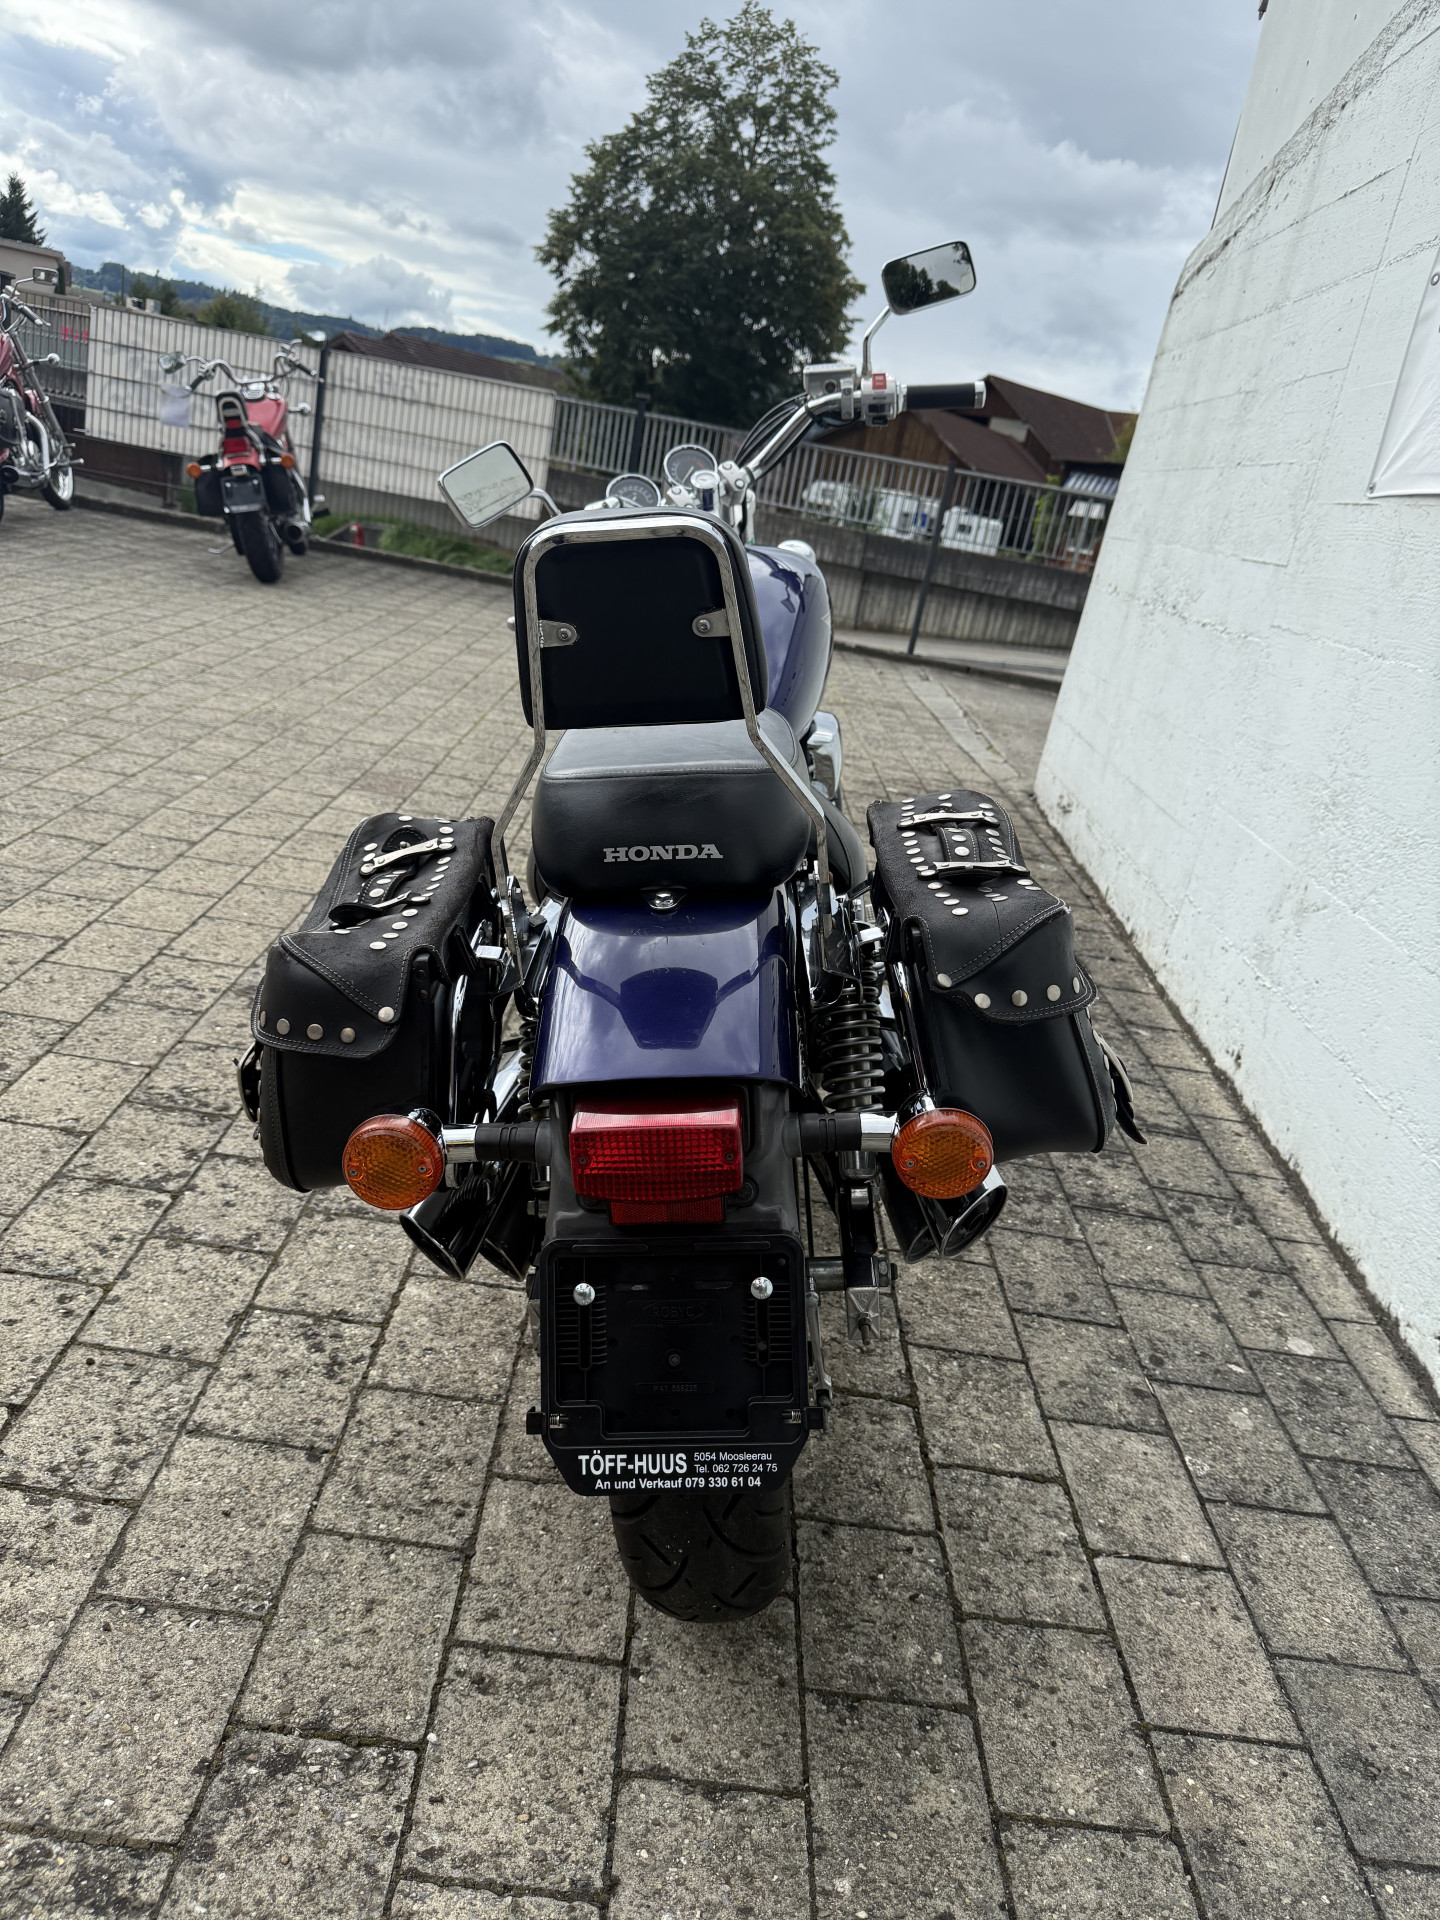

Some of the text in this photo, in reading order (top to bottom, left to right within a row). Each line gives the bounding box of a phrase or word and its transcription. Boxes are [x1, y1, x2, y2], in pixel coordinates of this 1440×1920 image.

[603, 844, 724, 863] HONDA
[578, 1450, 687, 1475] TÖFF-HUUS
[694, 1452, 772, 1461] 5054 Moosleerau
[694, 1463, 778, 1473] Tel. 062 726 24 75
[595, 1476, 761, 1490] An und Verkauf 079 330 61 04
